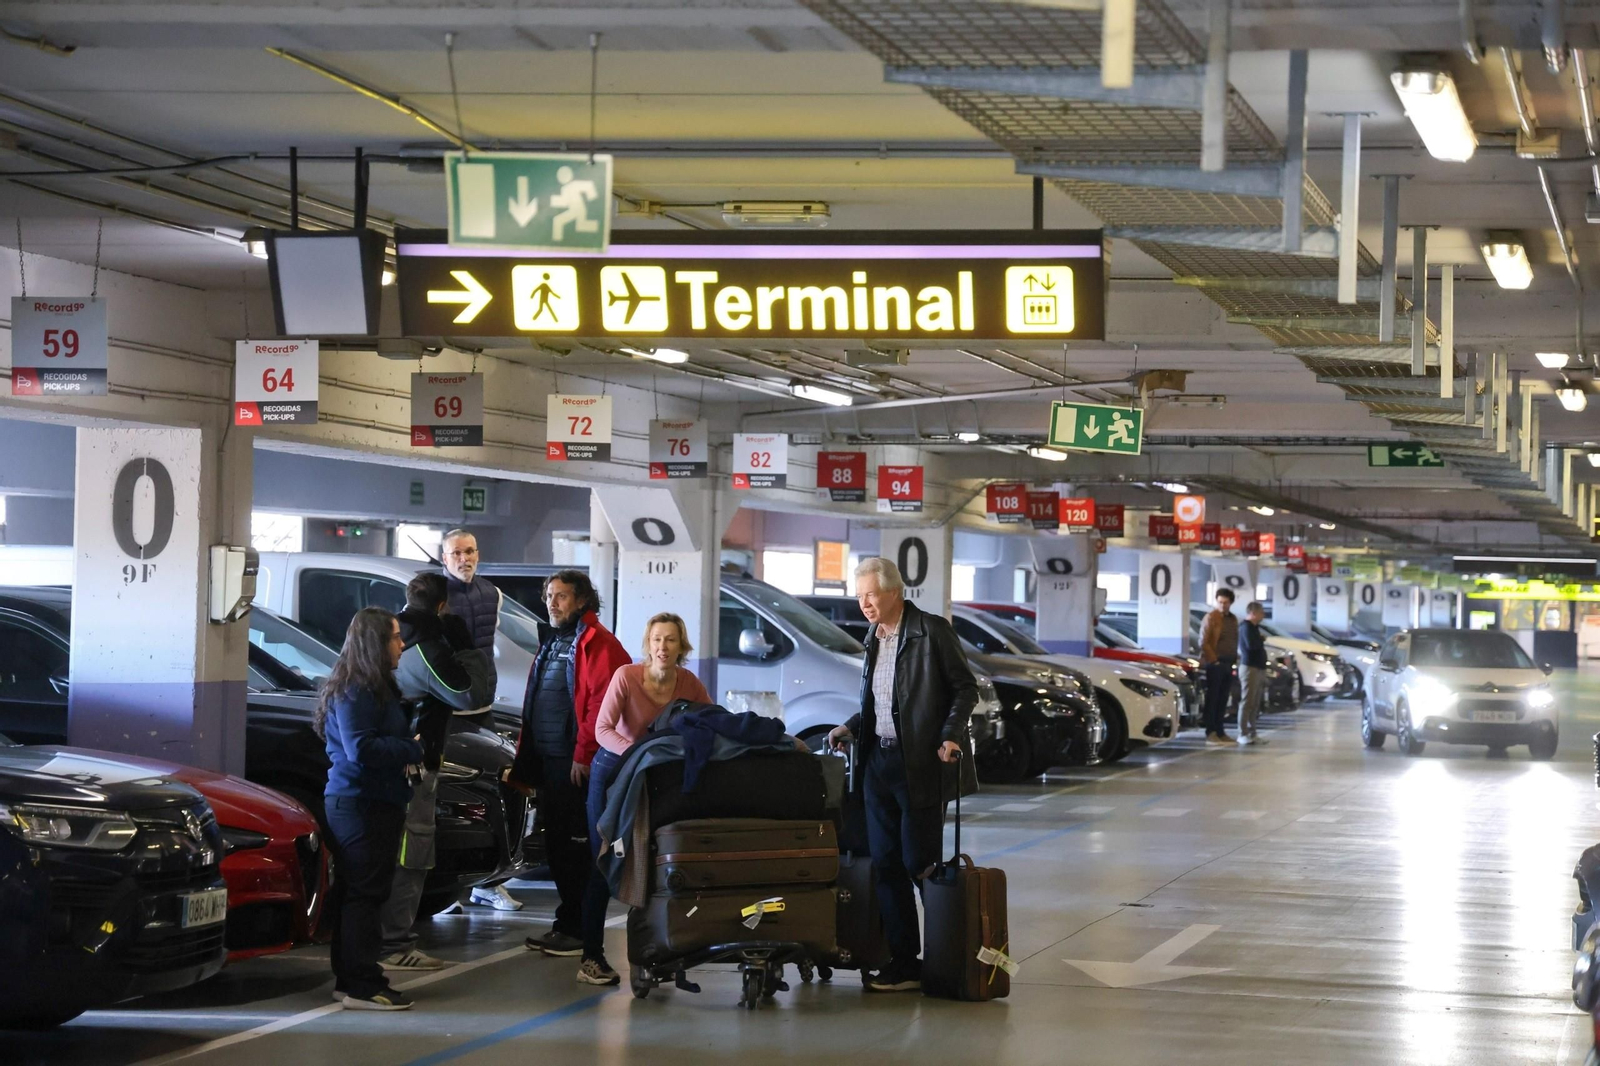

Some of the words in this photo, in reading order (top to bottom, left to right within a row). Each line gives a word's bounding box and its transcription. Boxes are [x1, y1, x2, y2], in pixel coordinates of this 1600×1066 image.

[675, 270, 975, 332] Terminal
[42, 328, 79, 358] 59
[43, 372, 87, 381] RECOGIDAS
[262, 367, 294, 393] 64
[43, 382, 80, 391] PICK-UPS
[263, 405, 301, 413] RECOGIDAS
[433, 395, 462, 418] 69
[263, 413, 295, 421] PICK-UPS
[567, 416, 592, 436] 72
[667, 438, 690, 456] 76
[750, 451, 771, 468] 82
[832, 468, 852, 484] 88
[891, 481, 910, 496] 94
[112, 457, 175, 560] 0
[995, 496, 1019, 509] 108
[1031, 503, 1053, 516] 114
[1066, 509, 1088, 521] 120
[1098, 515, 1119, 526] 126
[631, 517, 676, 546] 0
[1179, 529, 1196, 540] 136
[1220, 537, 1236, 547] 146
[648, 561, 679, 574] 10F
[897, 537, 929, 587] 0
[1046, 557, 1073, 574] 0
[1150, 563, 1172, 597] 0
[1225, 575, 1245, 588] 0
[1283, 575, 1300, 601] 0
[1361, 584, 1375, 605] 0
[189, 896, 209, 923] 0864
